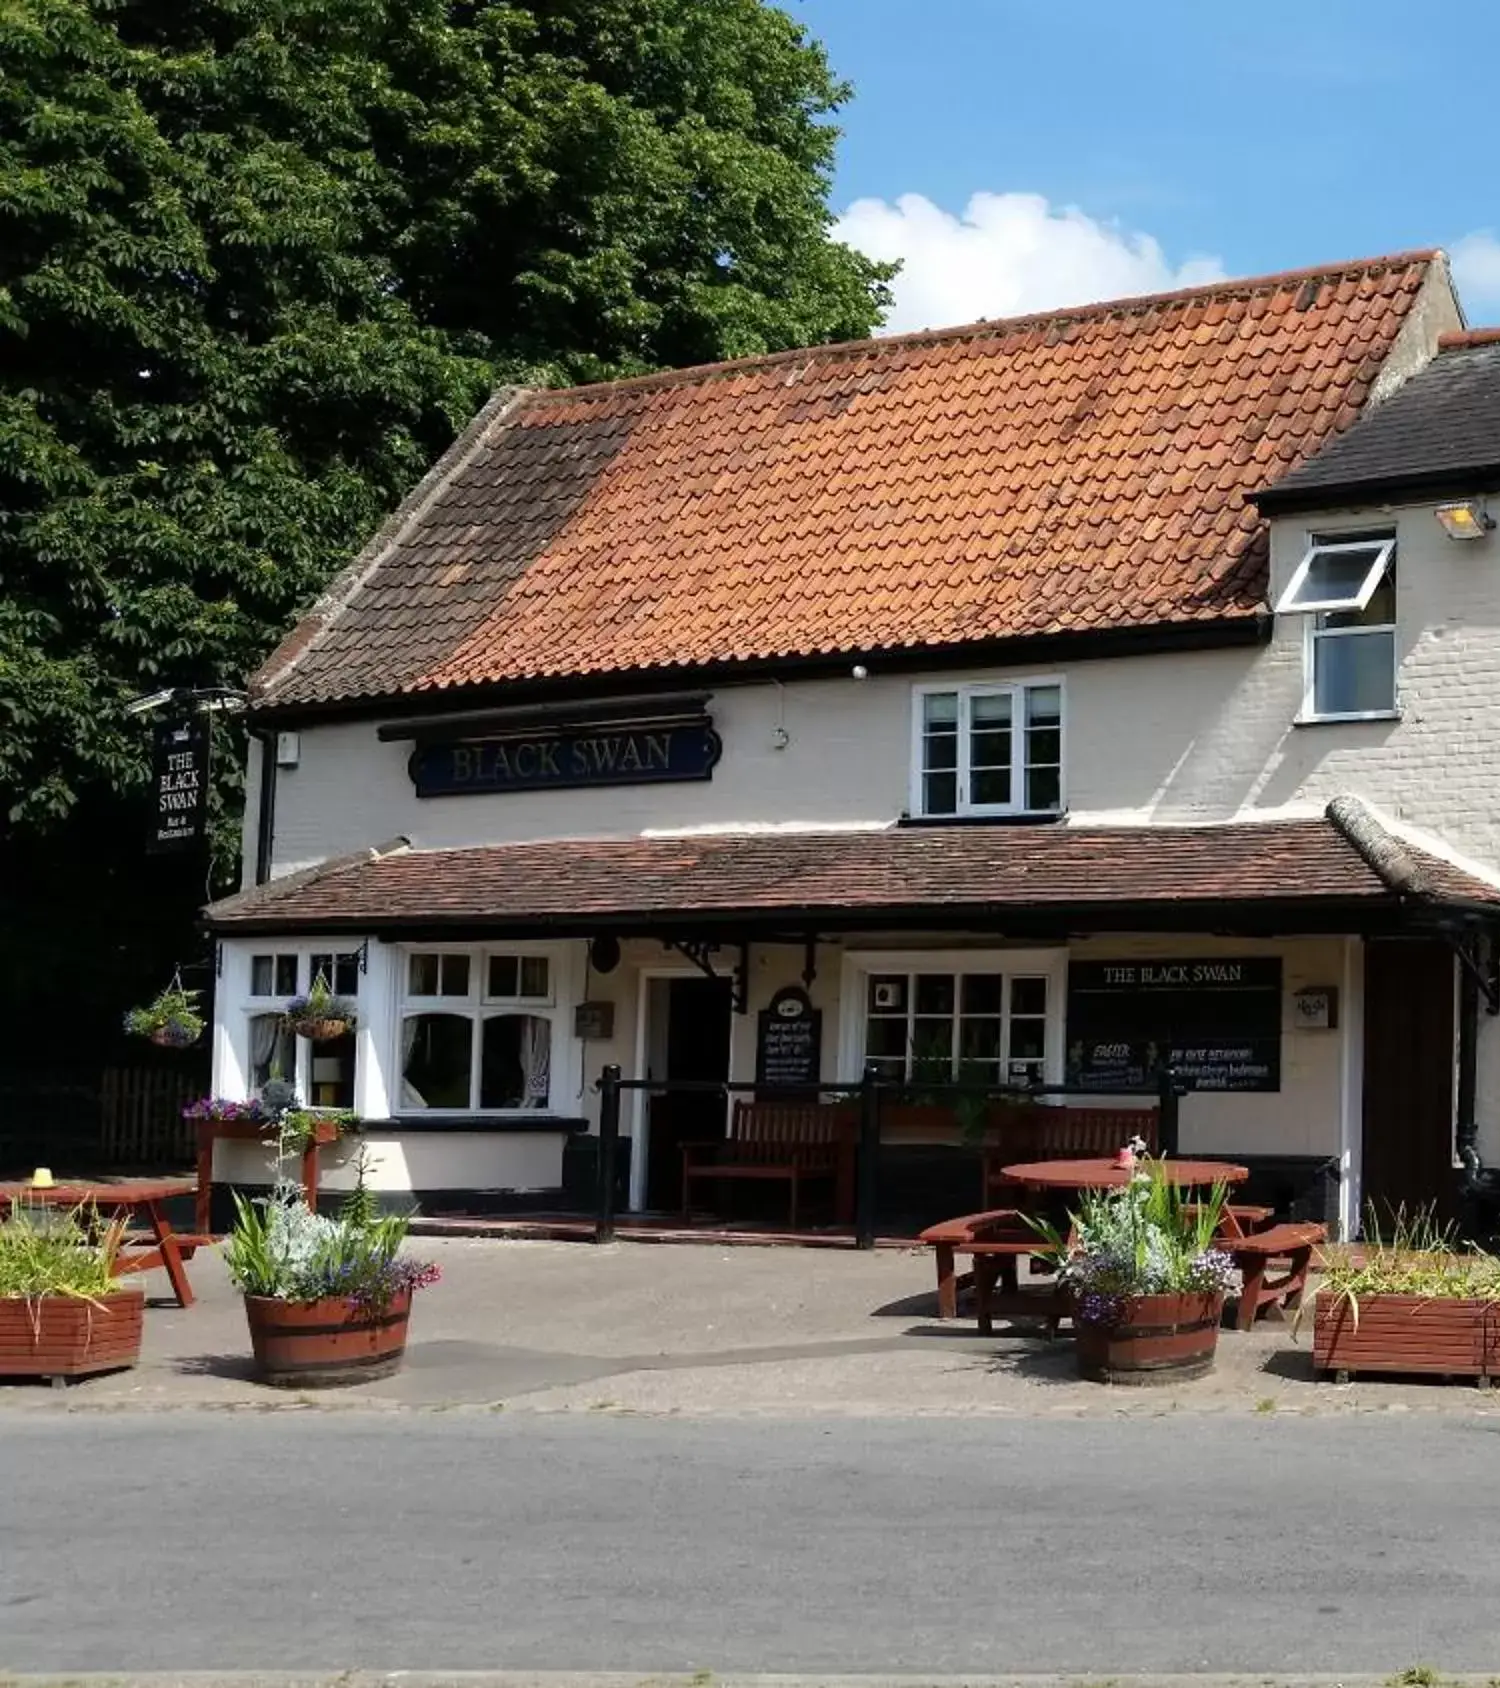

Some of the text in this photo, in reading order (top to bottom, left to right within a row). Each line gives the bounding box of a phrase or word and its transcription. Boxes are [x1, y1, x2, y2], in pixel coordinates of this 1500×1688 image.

[168, 751, 193, 771] THE
[453, 734, 671, 781] BLACK SWAN
[160, 769, 199, 792] BLACK
[160, 789, 197, 812] SWAN
[1104, 965, 1241, 984] THE BLACK SWAN
